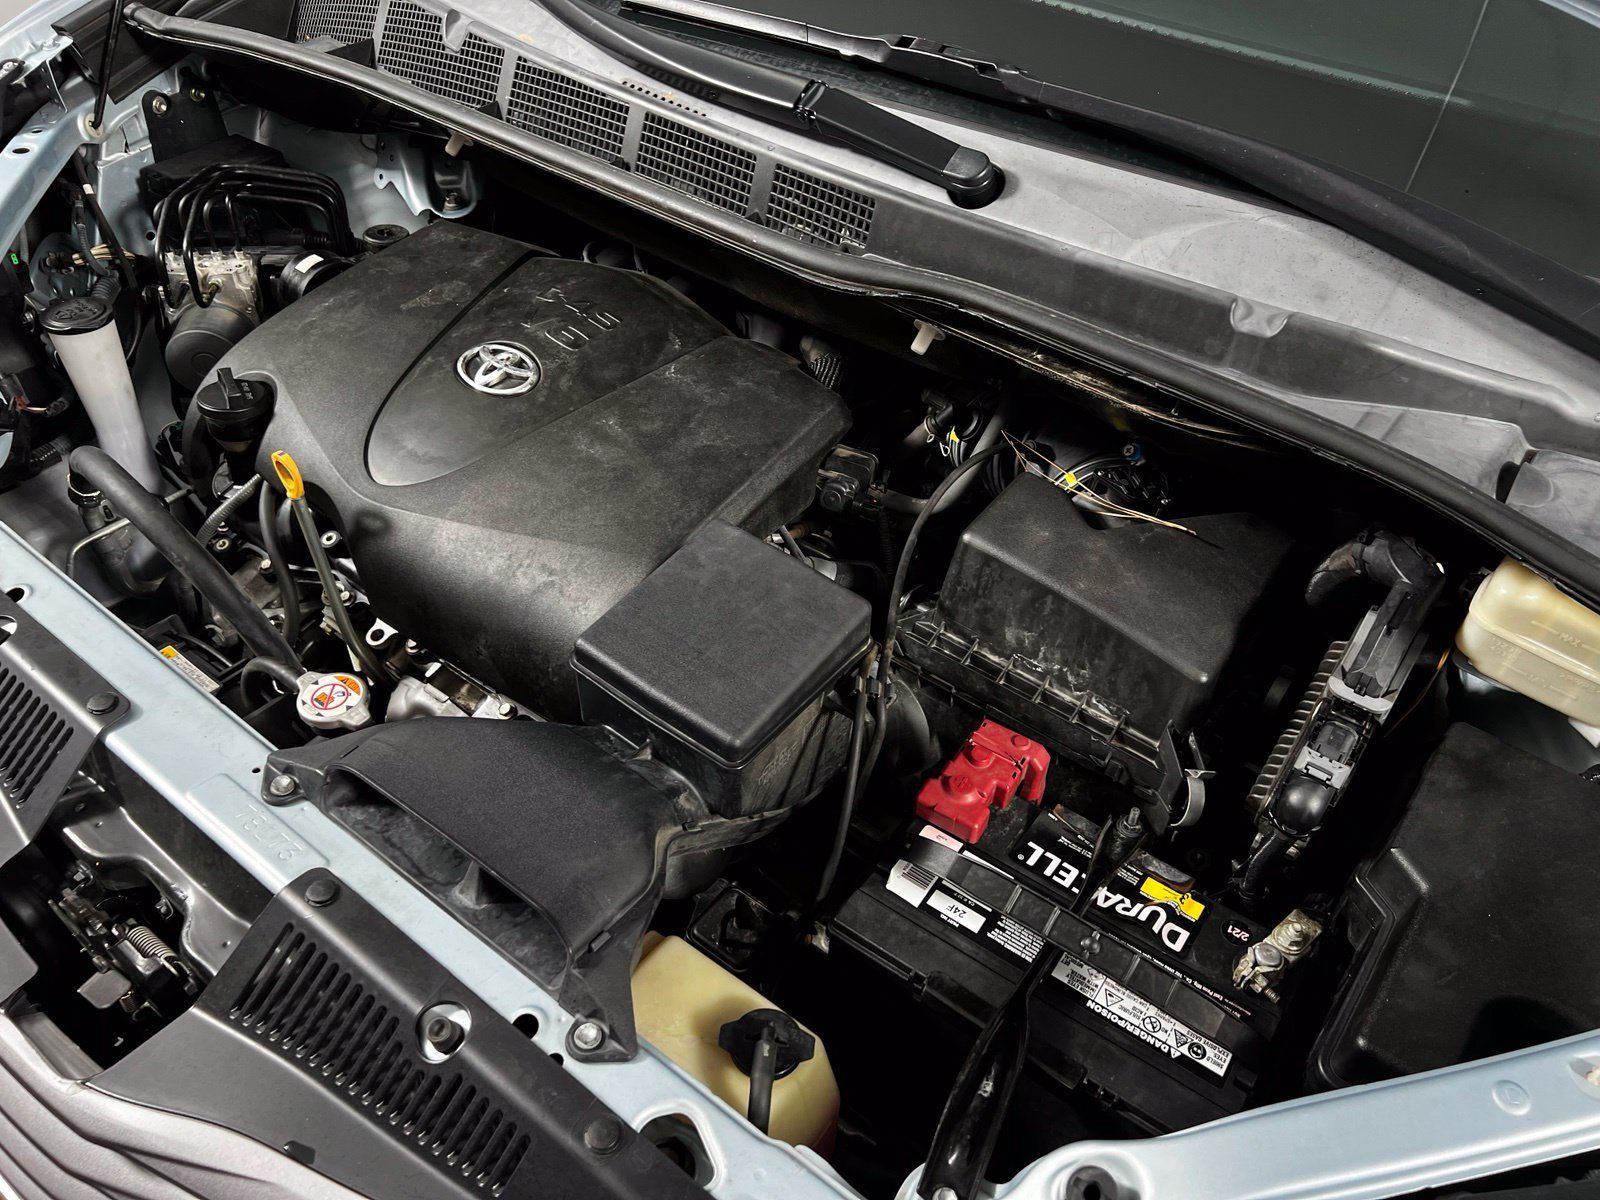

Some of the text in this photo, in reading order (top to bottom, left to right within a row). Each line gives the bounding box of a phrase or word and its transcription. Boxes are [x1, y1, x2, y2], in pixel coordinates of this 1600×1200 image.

[945, 901, 966, 919] 24F
[1226, 923, 1250, 943] 2/21
[1065, 972, 1096, 993] IMMEDIATELY
[1086, 979, 1098, 988] WITH
[1078, 986, 1093, 997] FLUSH
[1117, 1003, 1141, 1020] SULFURIC
[1131, 1005, 1143, 1015] ACID
[1085, 997, 1170, 1054] DANGER/POISON
[1186, 1029, 1229, 1058] EXPLOSIVE GASES
[1205, 1055, 1224, 1069] SHIELD
